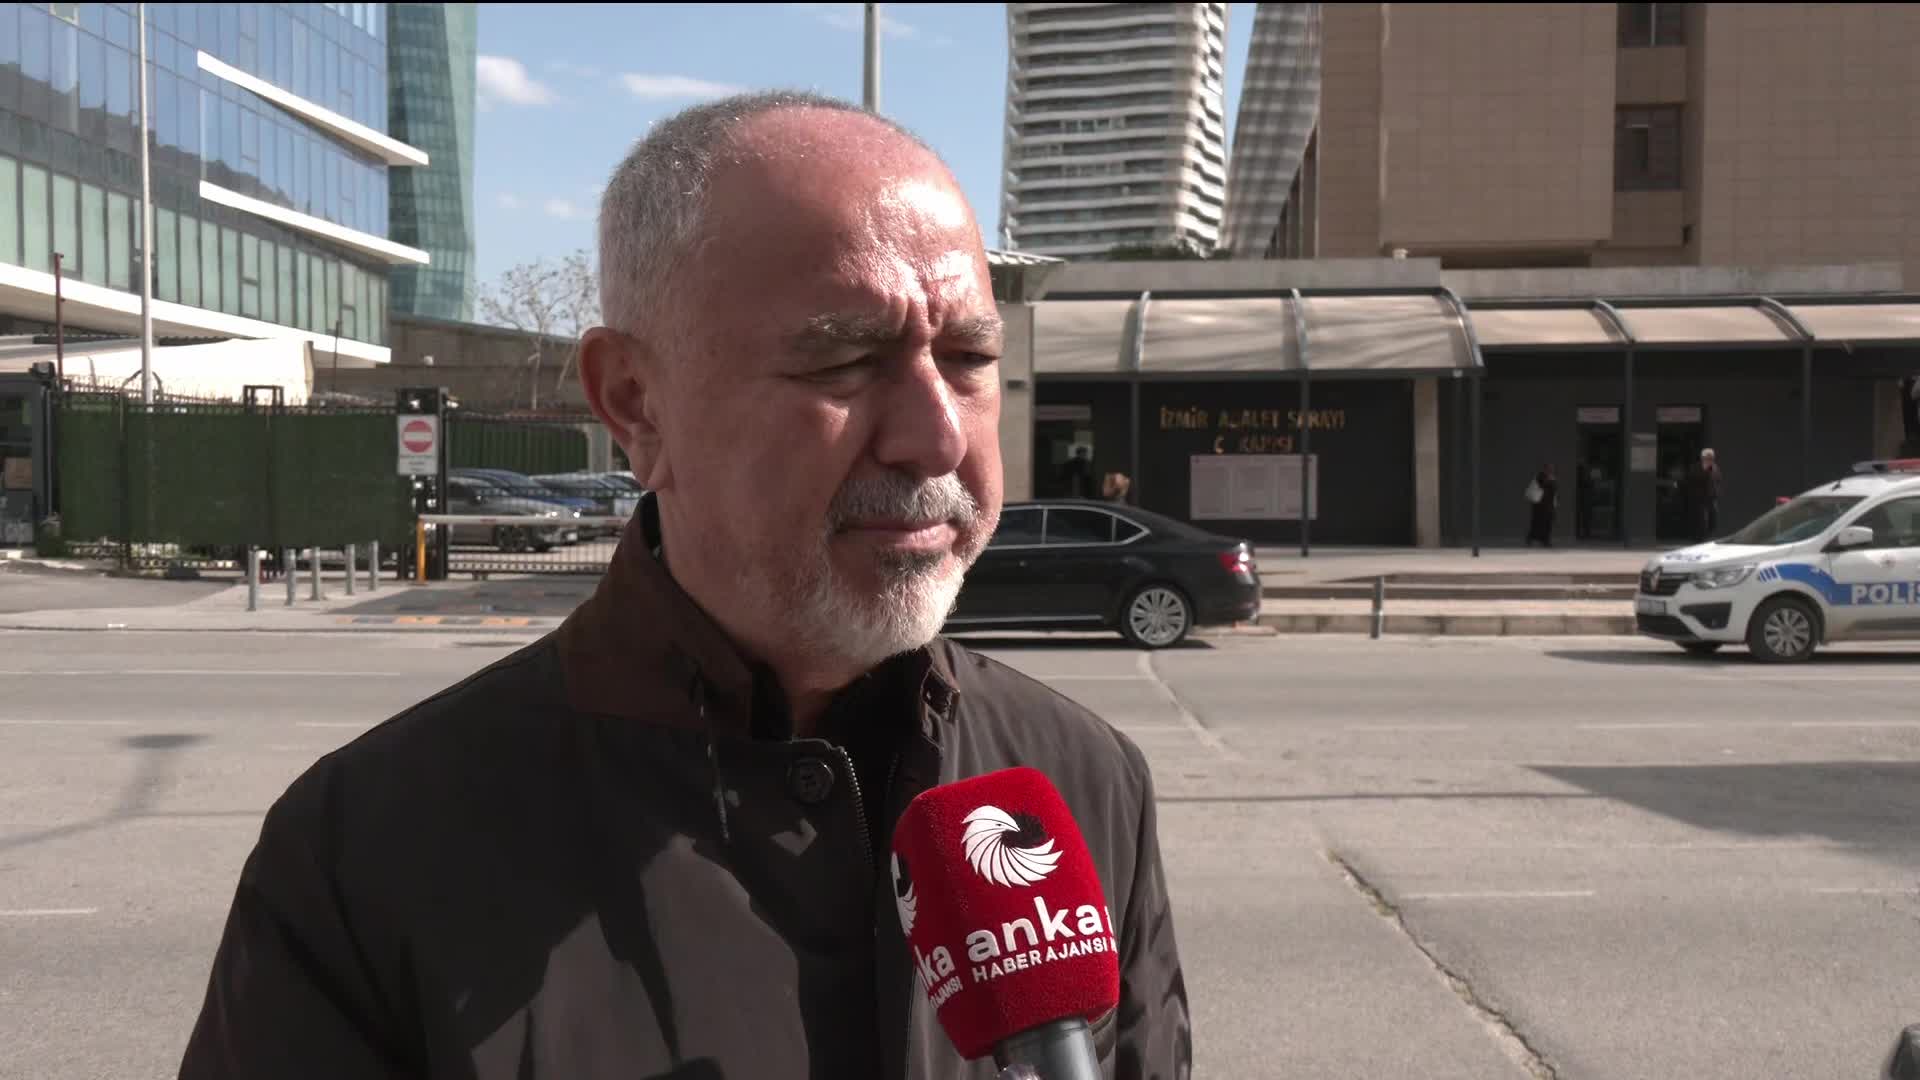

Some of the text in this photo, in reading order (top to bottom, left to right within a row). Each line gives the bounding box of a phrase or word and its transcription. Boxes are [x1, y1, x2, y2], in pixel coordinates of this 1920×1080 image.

[1160, 404, 1208, 430] İZMİR
[1851, 582, 1920, 605] POLİ
[966, 896, 1104, 962] anka
[971, 948, 1043, 983] HABER
[1045, 936, 1109, 962] AJANSI
